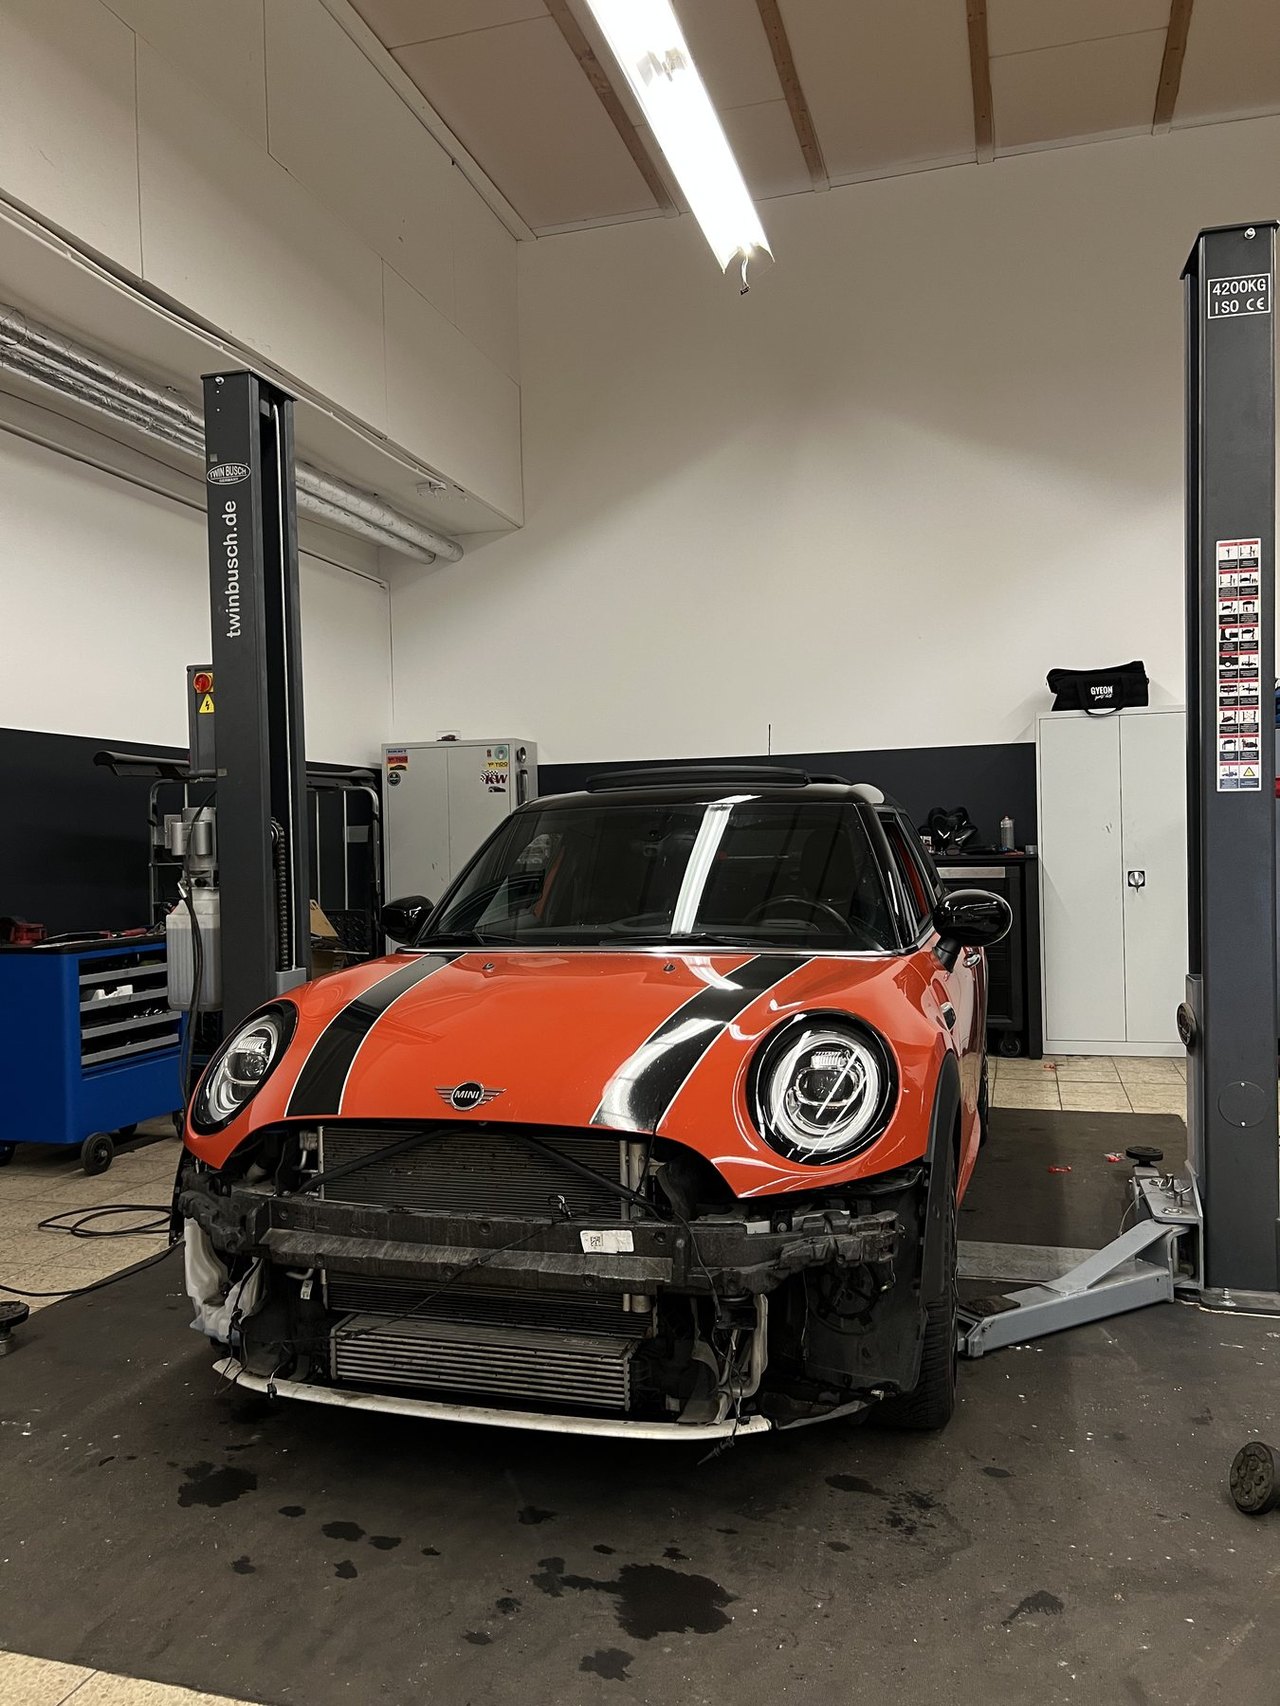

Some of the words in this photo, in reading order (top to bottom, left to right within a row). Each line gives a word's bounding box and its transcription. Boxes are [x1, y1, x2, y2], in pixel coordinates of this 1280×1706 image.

[1212, 278, 1266, 296] 4200KG
[1215, 300, 1239, 314] ISO
[1246, 297, 1265, 311] CE
[225, 465, 247, 477] BUSCH
[221, 500, 241, 638] twinbusch.de
[1090, 686, 1113, 695] GYEON
[454, 1090, 480, 1099] MINI
